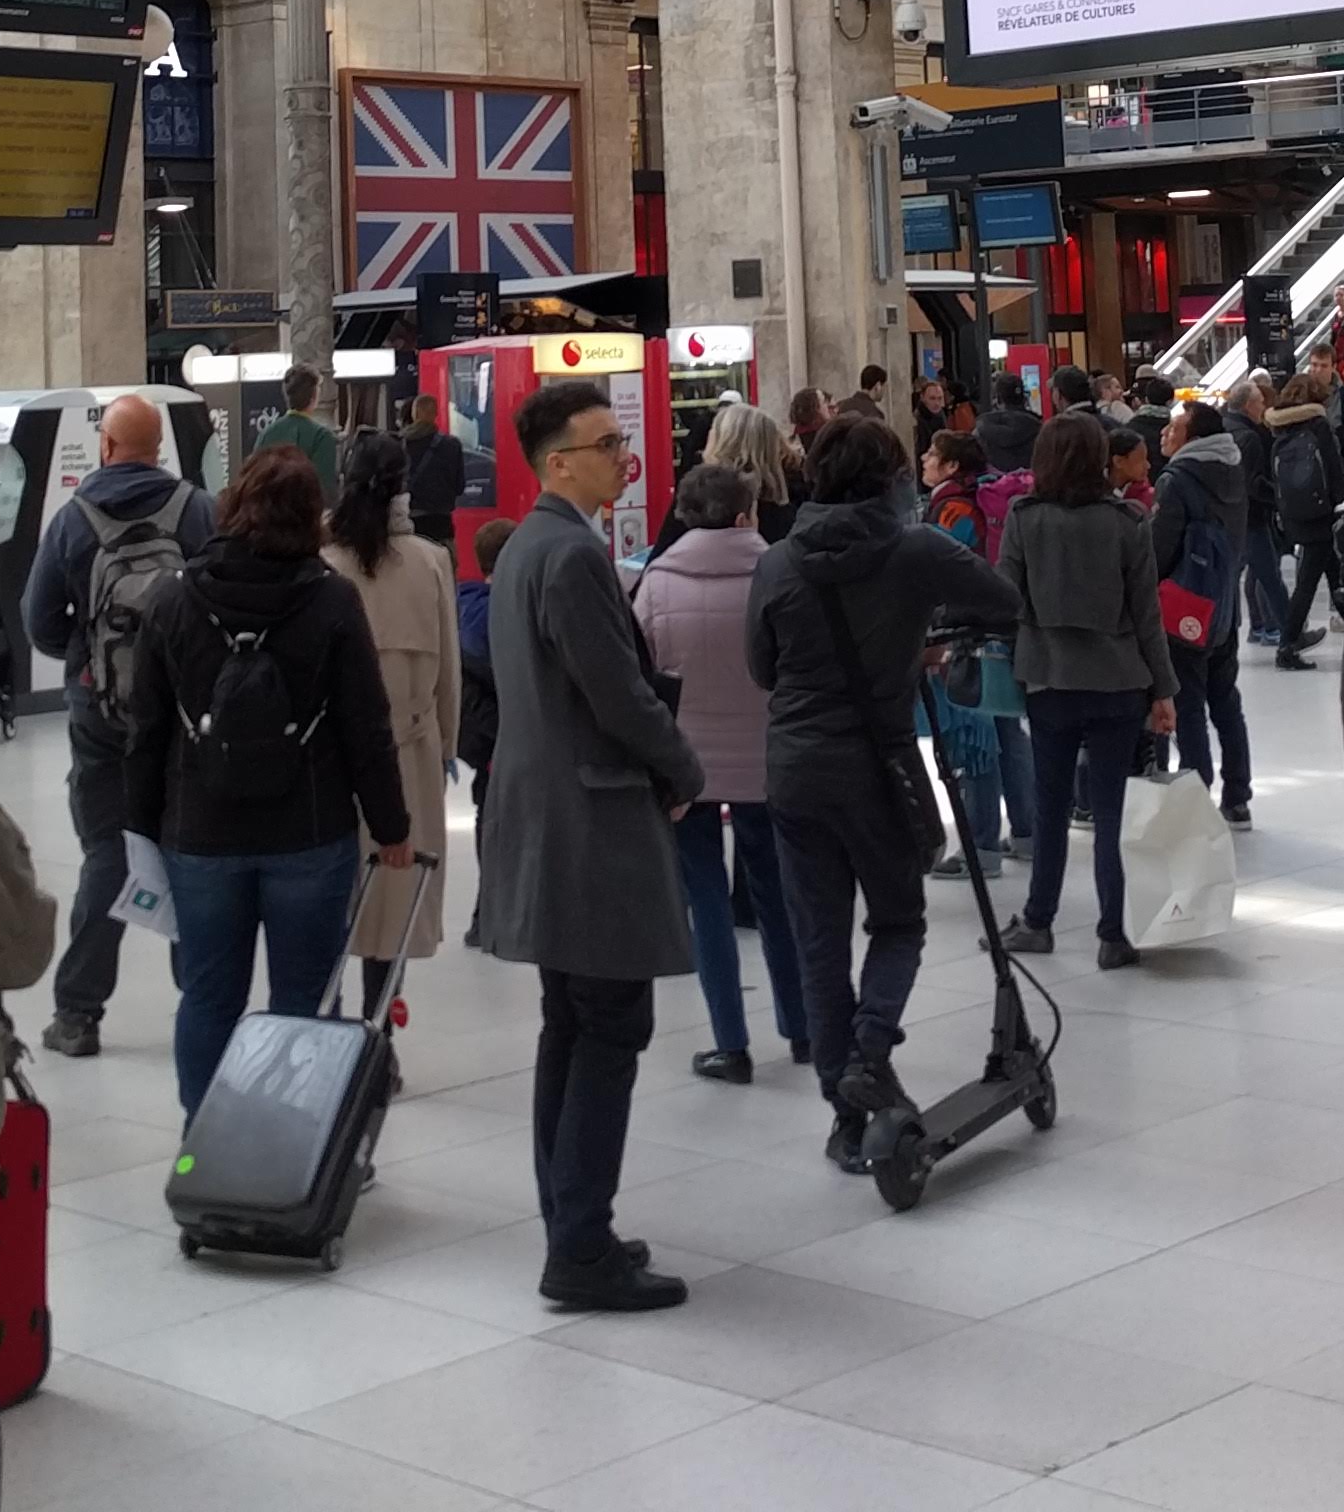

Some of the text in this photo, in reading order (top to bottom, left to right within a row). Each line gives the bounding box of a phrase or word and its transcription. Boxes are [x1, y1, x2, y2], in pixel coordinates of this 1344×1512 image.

[997, 6, 1022, 18] SNCF
[1024, 1, 1056, 15] GARES
[1057, 0, 1065, 10] &
[998, 3, 1136, 31] RÉVÉLATEUR DE CULTURES
[585, 346, 624, 360] selecta
